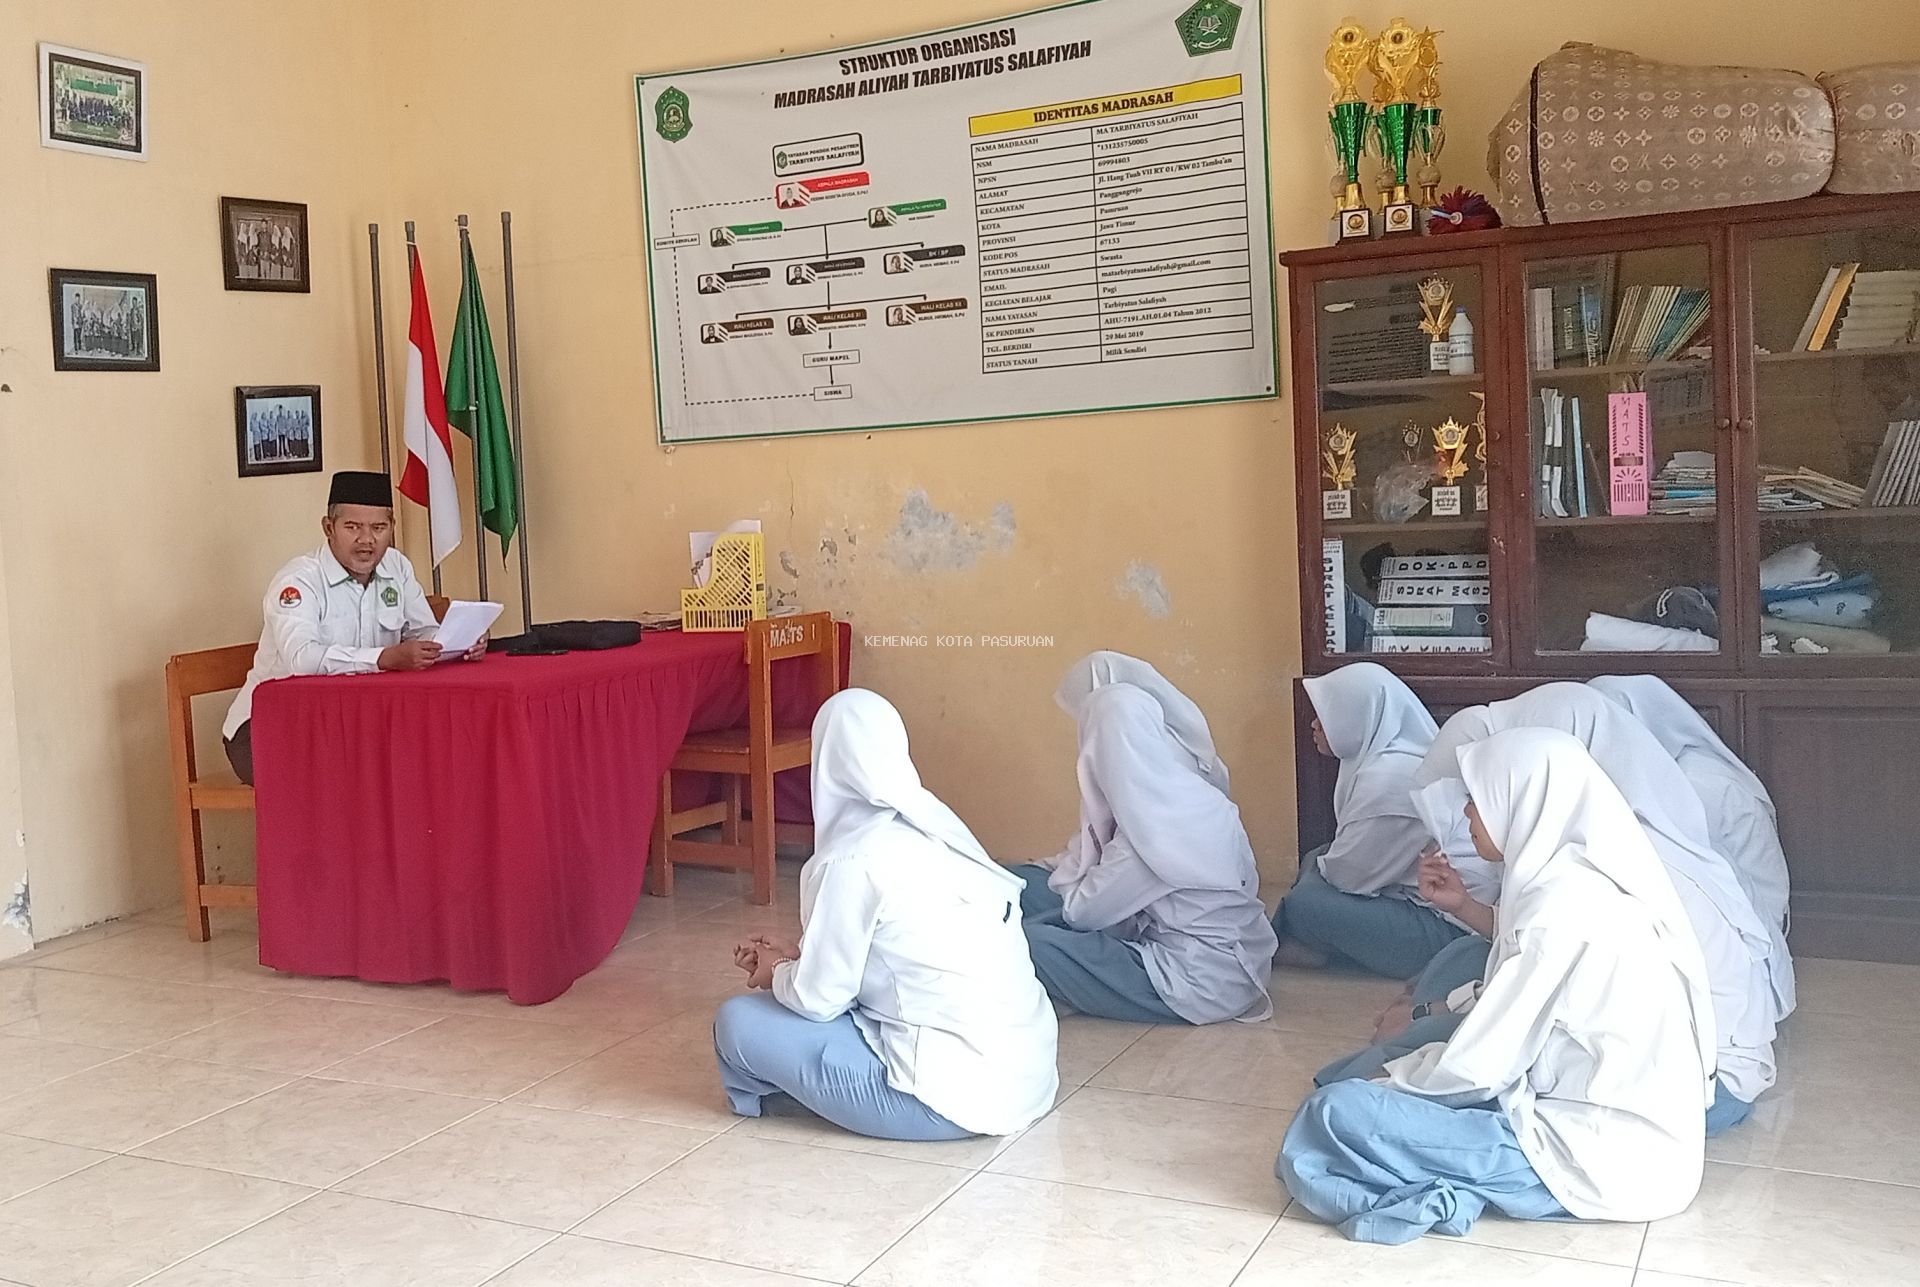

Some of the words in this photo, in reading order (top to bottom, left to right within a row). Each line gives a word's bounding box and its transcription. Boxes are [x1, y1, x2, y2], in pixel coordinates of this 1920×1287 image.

[839, 47, 919, 76] STRUKTUR
[920, 28, 1017, 62] ORGANISASI
[773, 82, 855, 109] MADRASAH
[858, 73, 909, 97] ALIYAH
[912, 56, 1004, 88] TARBIYATUS
[1007, 40, 1092, 71] SALAFIYAH
[1033, 103, 1099, 123] IDENTITAS
[1101, 92, 1174, 113] MADRASAH
[1110, 120, 1156, 133] TARBIYATUS
[1156, 113, 1198, 126] SALAFIYAH
[975, 144, 997, 153] NAMA
[997, 138, 1039, 150] MADRASAH
[976, 160, 993, 169] NSM
[977, 175, 997, 184] NPSN
[979, 190, 1009, 200] ALAMAT
[980, 203, 1025, 215] KECAMATAN
[981, 223, 1001, 231] KOTA
[982, 236, 1016, 246] PROVINSI
[983, 253, 1003, 262] KODE
[1003, 251, 1018, 259] POS
[983, 268, 1009, 277] STATUS
[1010, 263, 1050, 274] MADRASAH
[984, 284, 1007, 292] EMAIL
[1102, 285, 1117, 294] Pagi
[984, 298, 1020, 307] KEGIATAN
[1021, 294, 1052, 304] BELAJAR
[1103, 300, 1138, 309] Tarbiyatus
[1138, 296, 1167, 306] Salafiyah
[1195, 307, 1212, 315] 2012
[985, 314, 1006, 323] NAMA
[1007, 311, 1038, 320] YAYASAN
[996, 327, 1035, 337] PENDIRIAN
[1114, 331, 1127, 339] Mei
[1003, 343, 1032, 351] BERDIRI
[986, 360, 1012, 369] STATUS
[1013, 357, 1038, 366] TANAH
